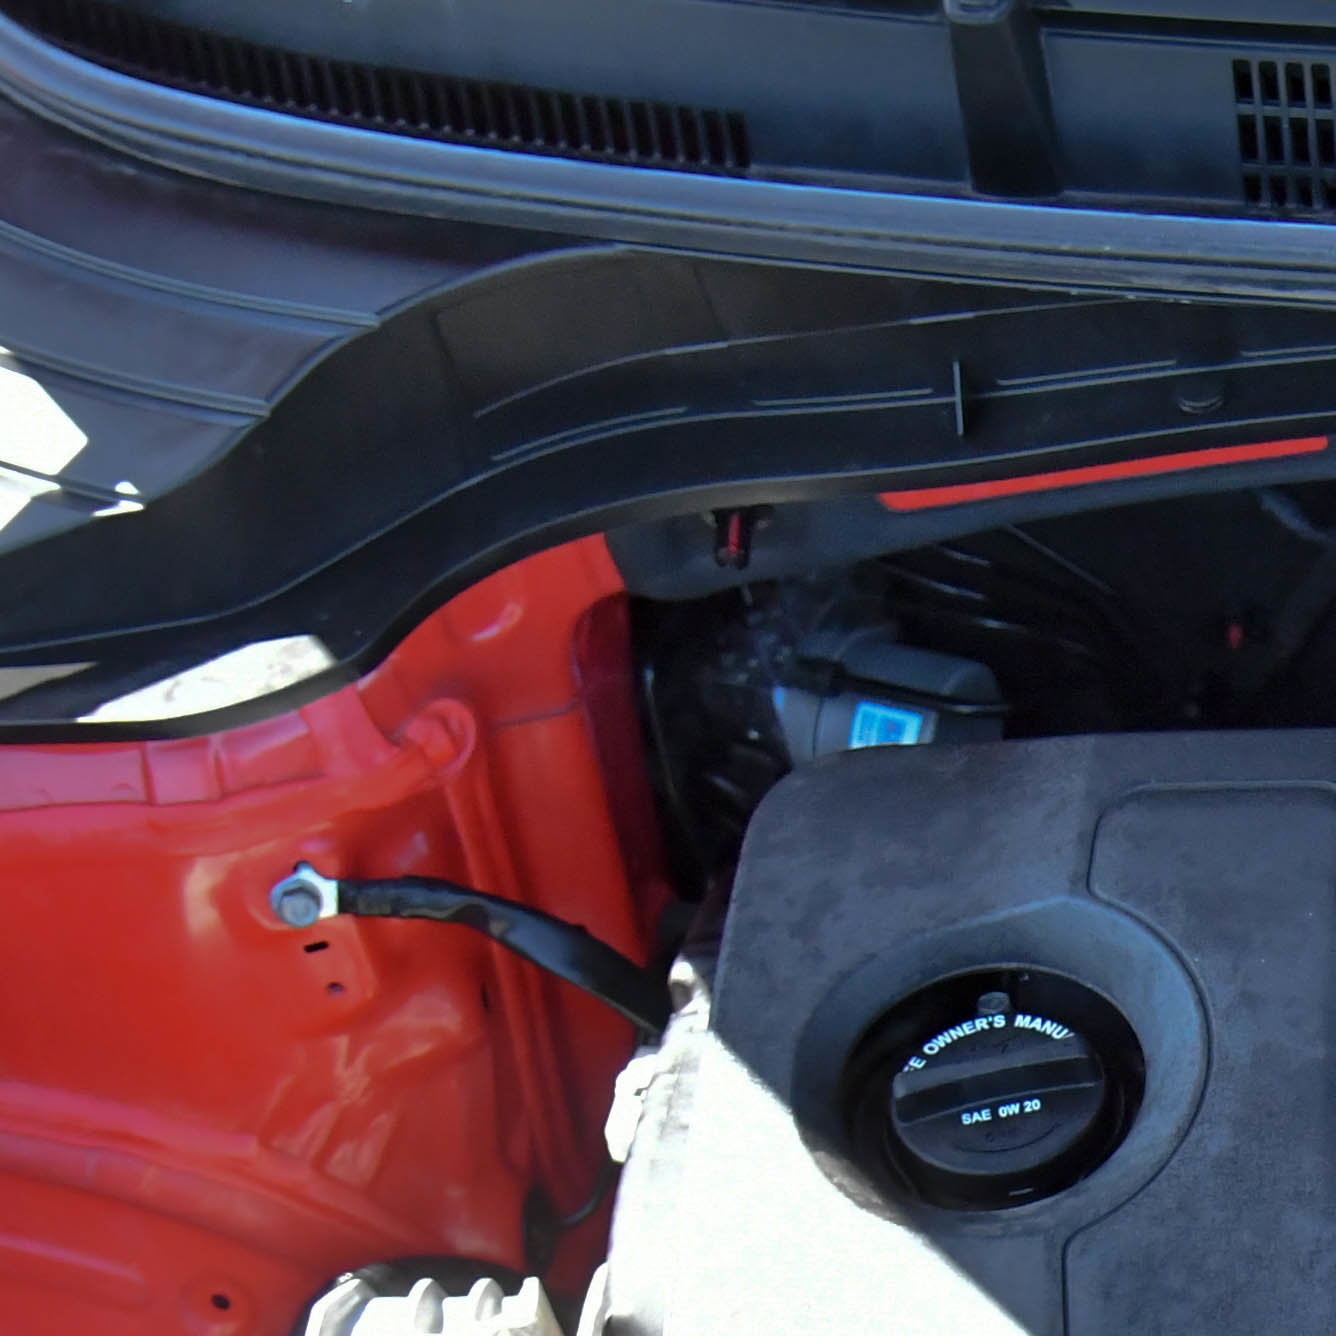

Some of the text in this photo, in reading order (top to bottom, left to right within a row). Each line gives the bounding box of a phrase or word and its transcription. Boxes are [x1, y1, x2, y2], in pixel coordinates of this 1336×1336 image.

[922, 1013, 1007, 1056] OWNER'S
[1013, 1013, 1076, 1041] MANU
[960, 1098, 1042, 1126] SAE 0W 20
